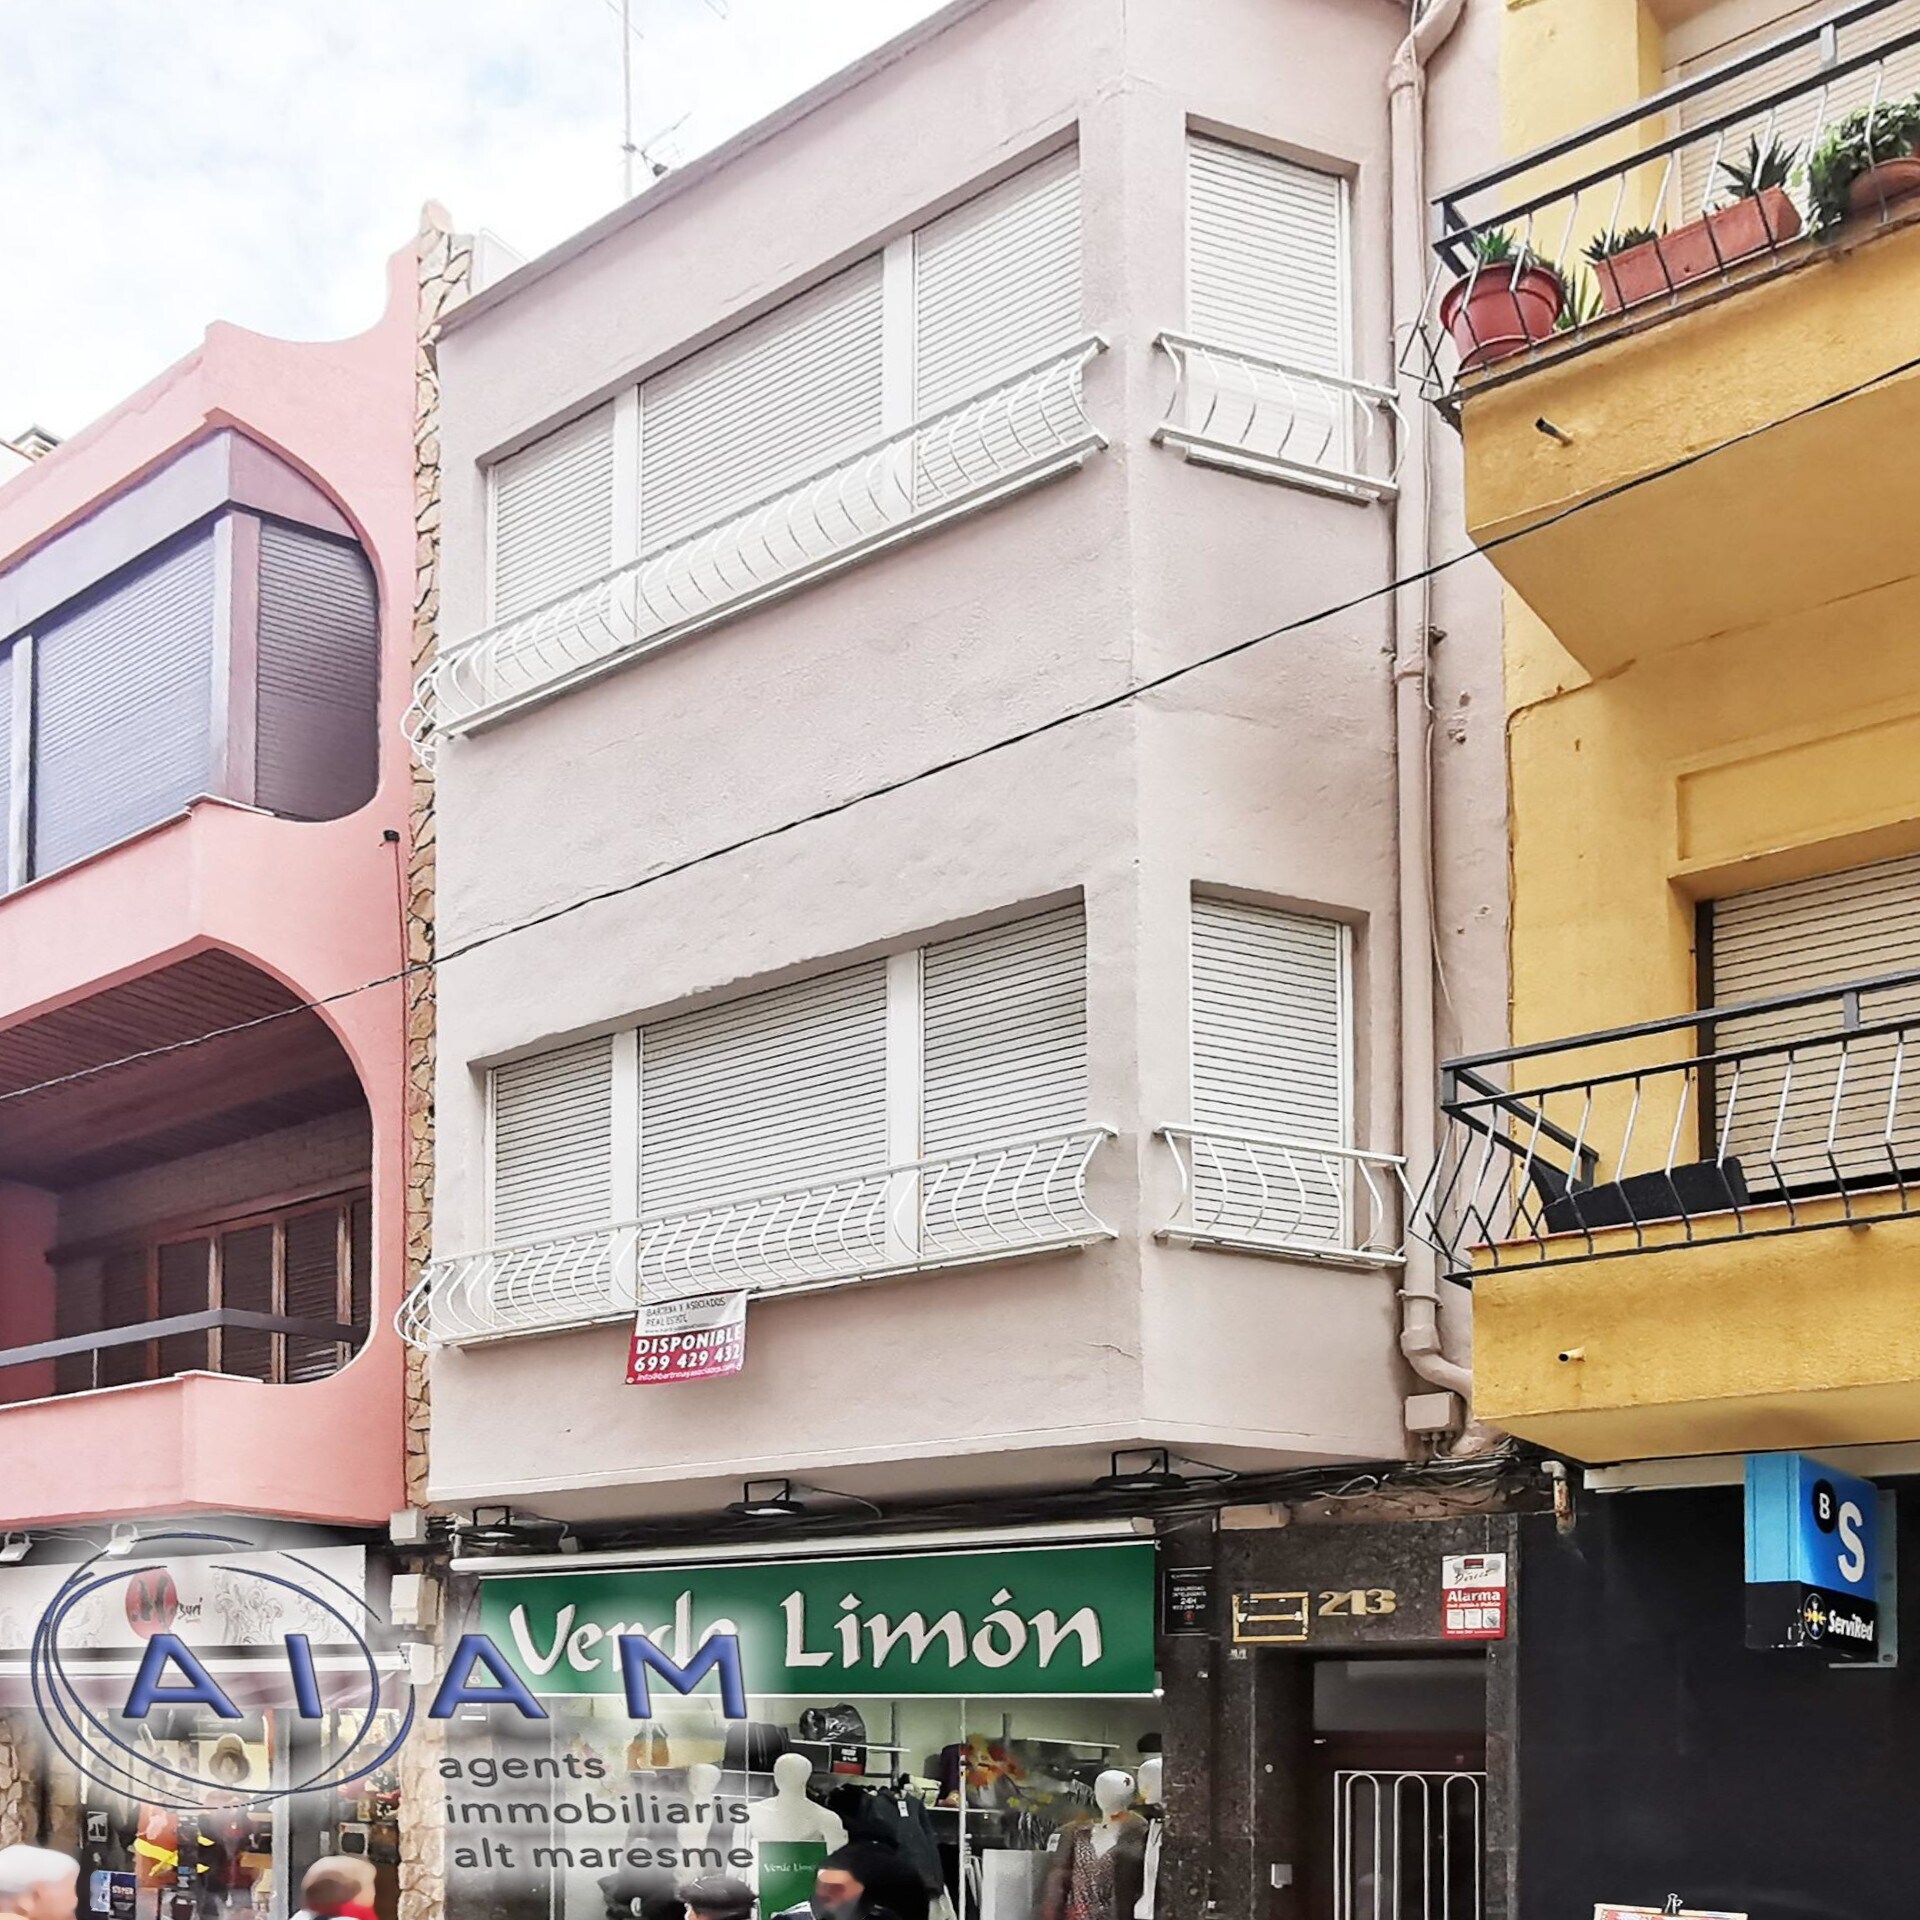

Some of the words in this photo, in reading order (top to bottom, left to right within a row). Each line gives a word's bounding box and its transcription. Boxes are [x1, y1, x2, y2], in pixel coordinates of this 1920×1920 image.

[636, 1326, 741, 1354] DISPONIBLE
[634, 1355, 670, 1372] 699
[677, 1350, 709, 1369] 429
[714, 1343, 740, 1363] 432
[1838, 1501, 1865, 1583] S
[1318, 1588, 1397, 1616] 213
[1447, 1590, 1500, 1602] Alarma
[780, 1588, 1102, 1669] Limón
[1828, 1610, 1874, 1642] ServiRed
